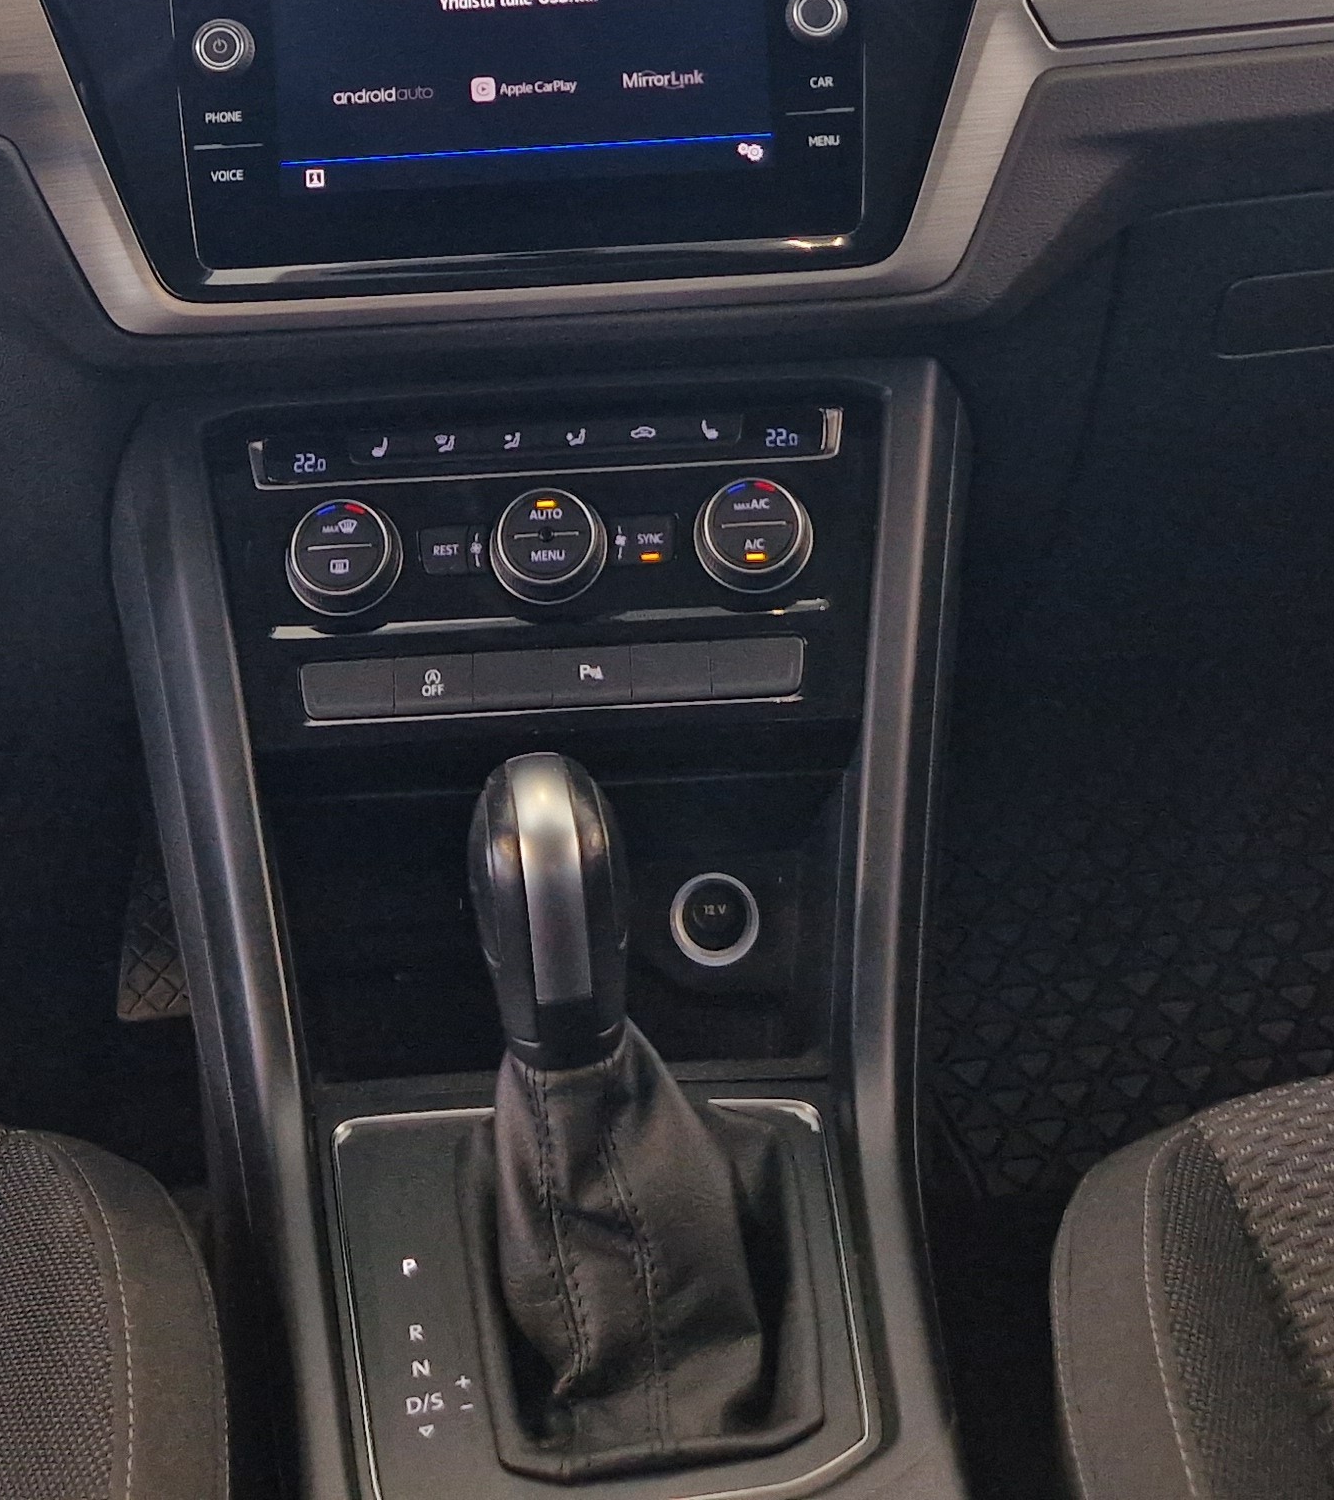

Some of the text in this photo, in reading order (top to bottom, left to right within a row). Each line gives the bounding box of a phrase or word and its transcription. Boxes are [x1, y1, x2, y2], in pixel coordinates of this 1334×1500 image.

[622, 70, 705, 90] MirrorLink
[809, 75, 834, 89] CAR
[499, 79, 577, 100] Apple CarPlay
[205, 110, 243, 124] PHONE
[808, 134, 841, 148] MENU
[210, 169, 245, 183] VOICE
[529, 508, 563, 521] AUTO
[637, 532, 664, 545] SYNC
[744, 538, 767, 550] A/C
[432, 543, 460, 557] REST
[530, 549, 566, 562] MENU
[421, 683, 445, 697] OFF
[401, 1257, 418, 1278] P
[408, 1324, 425, 1342] R
[410, 1358, 431, 1378] N
[405, 1390, 445, 1415] D/S
